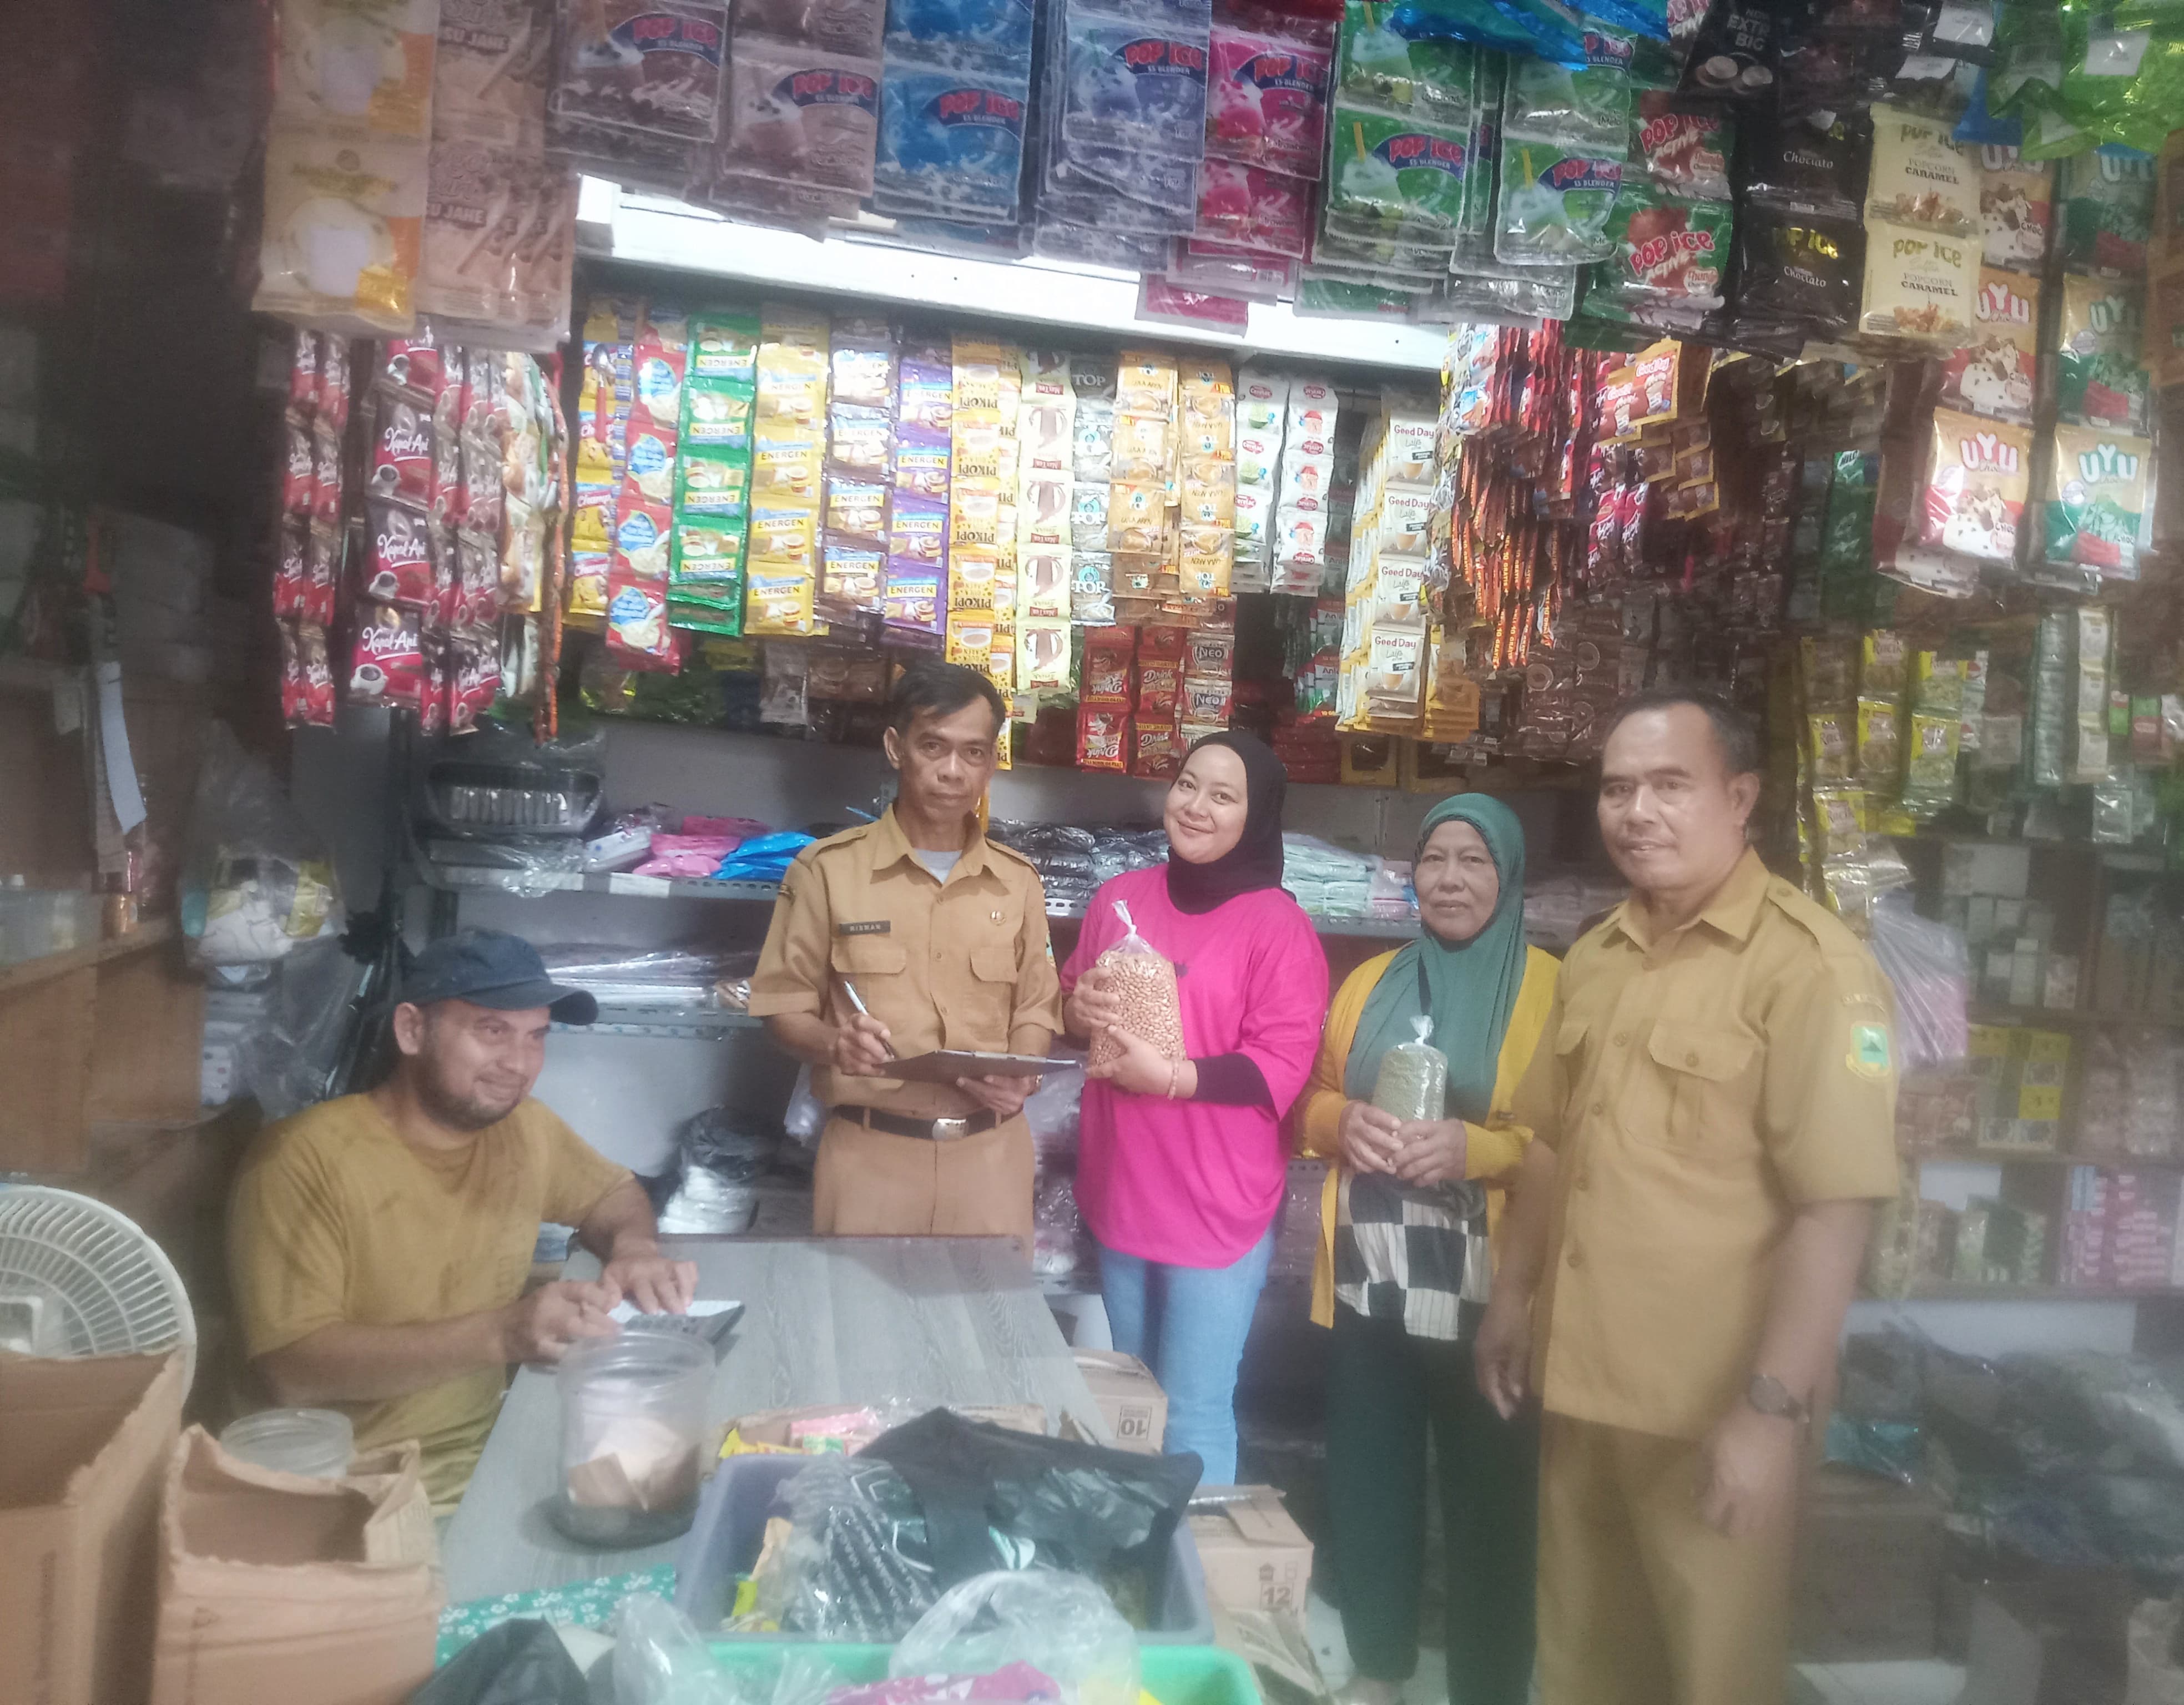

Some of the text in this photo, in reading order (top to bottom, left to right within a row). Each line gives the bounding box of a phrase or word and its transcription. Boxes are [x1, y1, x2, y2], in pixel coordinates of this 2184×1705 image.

[1736, 32, 1764, 51] BIG
[1124, 41, 1164, 69] POP
[1593, 56, 1623, 65] BLENDER
[1254, 57, 1293, 82] POP
[1639, 114, 1678, 154] POP
[1389, 136, 1426, 163] POP
[1553, 159, 1591, 187] POP
[1909, 158, 1955, 174] POPCORN
[1905, 167, 1960, 185] CARAMEL
[1583, 180, 1615, 188] BLENDER
[1628, 235, 1668, 278] POP
[1904, 273, 1953, 287] POPCORN
[1901, 280, 1959, 297] CARAMEL
[1976, 282, 2030, 324] UYU
[699, 359, 748, 367] ENERGEN
[1071, 372, 1107, 387] TOP
[959, 397, 998, 409] PIKOPI
[693, 426, 740, 435] ENERGEN
[1394, 425, 1435, 439] Good Day
[411, 433, 430, 455] Api
[761, 451, 808, 461] ENERGEN
[1960, 431, 2019, 472] UYU
[901, 456, 944, 465] ENERGEN
[1838, 450, 1859, 468] MILO
[2078, 443, 2138, 483] UYU
[959, 464, 997, 476] PIKOPI
[688, 495, 736, 503] ENERGEN
[834, 495, 880, 503] ENERGEN
[1388, 496, 1430, 511] Good Day
[756, 519, 804, 528] ENERGEN
[896, 521, 939, 529] ENERGEN
[956, 531, 995, 543] PIKOPI
[377, 533, 426, 562] Kapal Api
[683, 562, 731, 571] ENERGEN
[1381, 566, 1423, 580] Good Day
[753, 587, 800, 596] ENERGEN
[891, 586, 934, 594] ENERGEN
[954, 597, 992, 609] PIKOPI
[1496, 627, 1502, 638] 10
[362, 627, 418, 655] Kapal Api
[1375, 636, 1416, 649] Good Day
[1198, 646, 1223, 658] NEO
[1143, 669, 1173, 683] Drink
[1091, 680, 1123, 694] Drink
[1195, 694, 1220, 706] NEO
[1140, 732, 1169, 747] Drink
[1087, 744, 1119, 759] Drink
[1119, 1419, 1147, 1436] 10
[1262, 1586, 1292, 1605] 12
